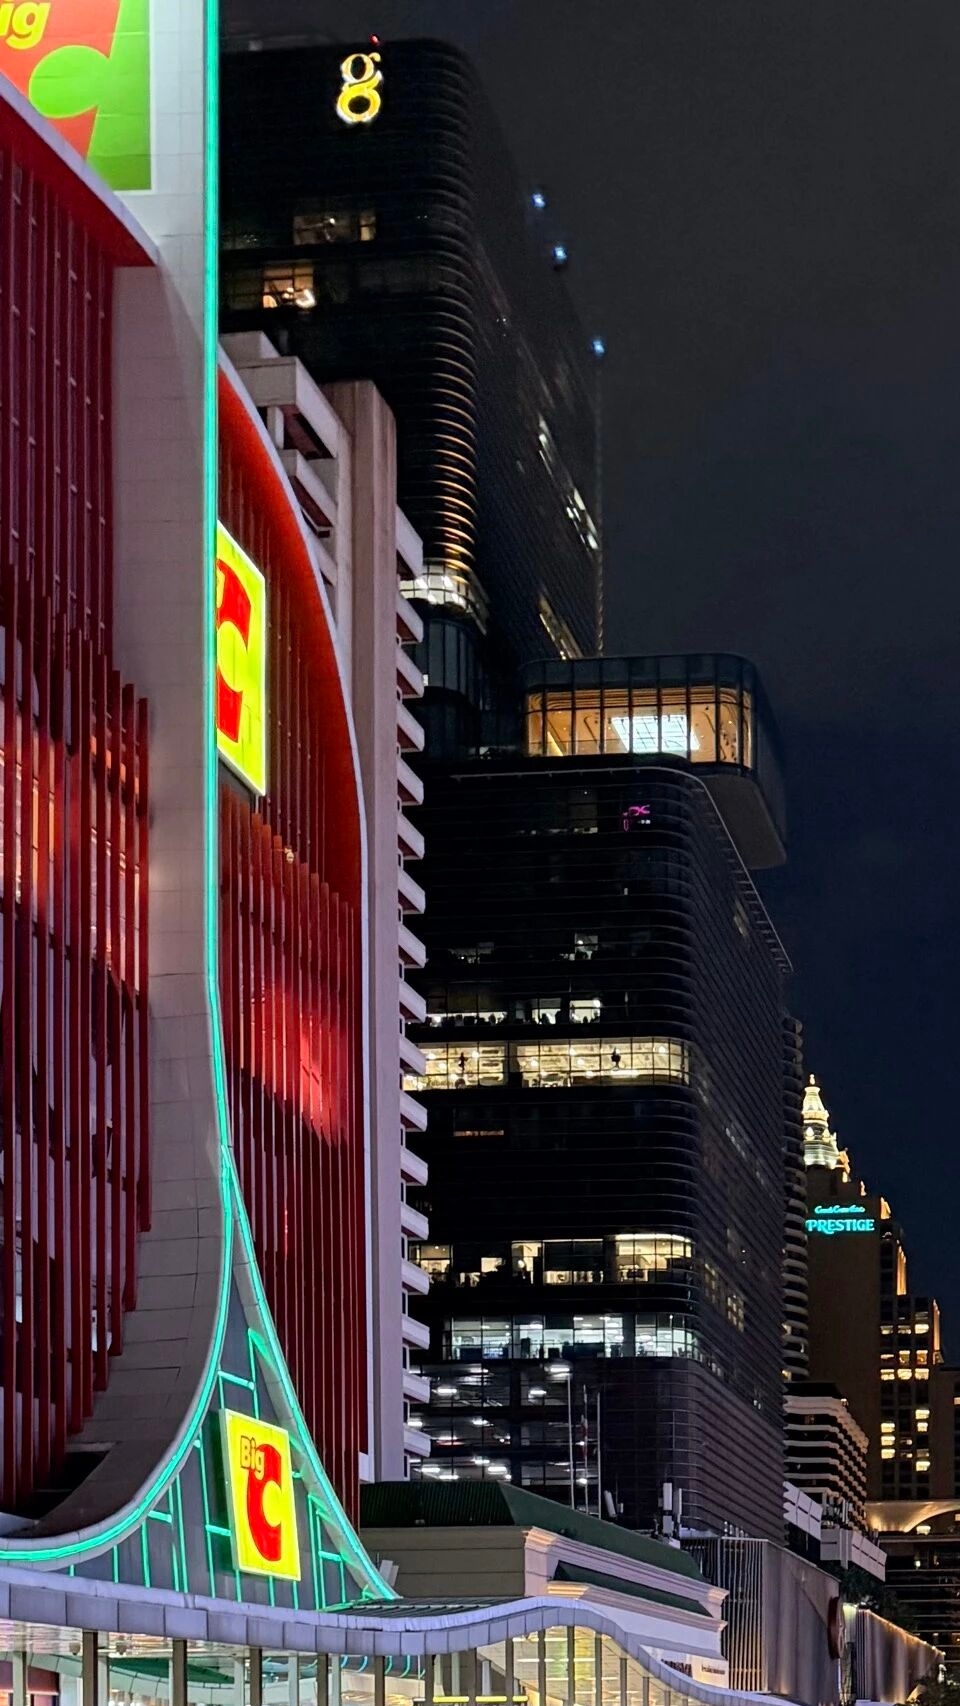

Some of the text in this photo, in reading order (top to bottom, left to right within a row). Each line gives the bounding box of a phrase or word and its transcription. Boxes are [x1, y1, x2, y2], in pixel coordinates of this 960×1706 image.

[0, 0, 51, 49] ig
[336, 51, 382, 124] g
[805, 1219, 875, 1234] PRESTIGE
[240, 1435, 282, 1562] Big C
